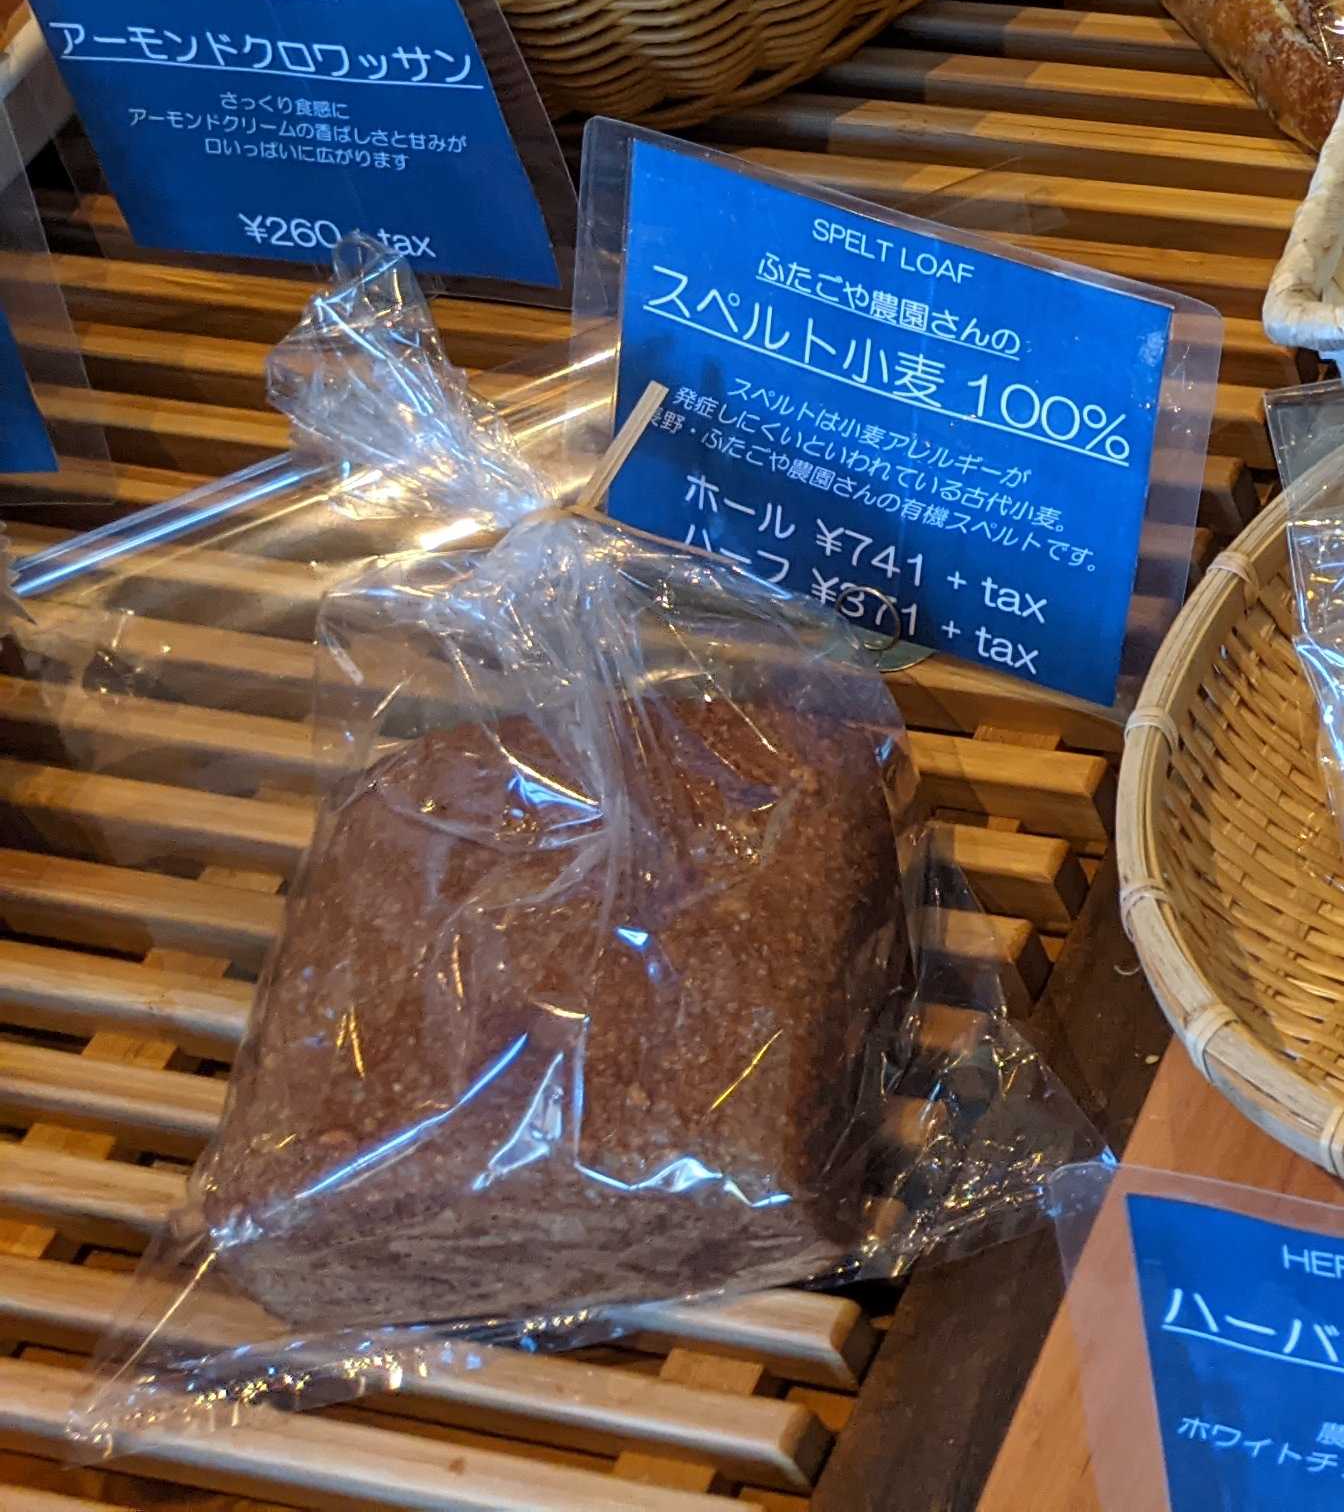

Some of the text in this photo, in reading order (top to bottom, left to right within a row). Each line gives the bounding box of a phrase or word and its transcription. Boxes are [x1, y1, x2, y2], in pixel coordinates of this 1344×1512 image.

[48, 21, 473, 84] アーモンドクロワッサン
[218, 91, 351, 120] さっくり食感に
[204, 136, 411, 171] 口いっぱいに広がります
[237, 212, 342, 250] ¥260
[811, 217, 976, 285] SPELT LOAF
[757, 250, 1022, 357] ふたごや農園さんの
[646, 263, 1131, 463] スペルト小麦 100%
[726, 377, 1034, 490] スペルトは小麦アレルギーが
[684, 472, 796, 541] ホール
[814, 518, 924, 588] ¥741
[980, 576, 1049, 626] tax
[684, 524, 790, 583] ハーフ
[974, 626, 1041, 675] tax
